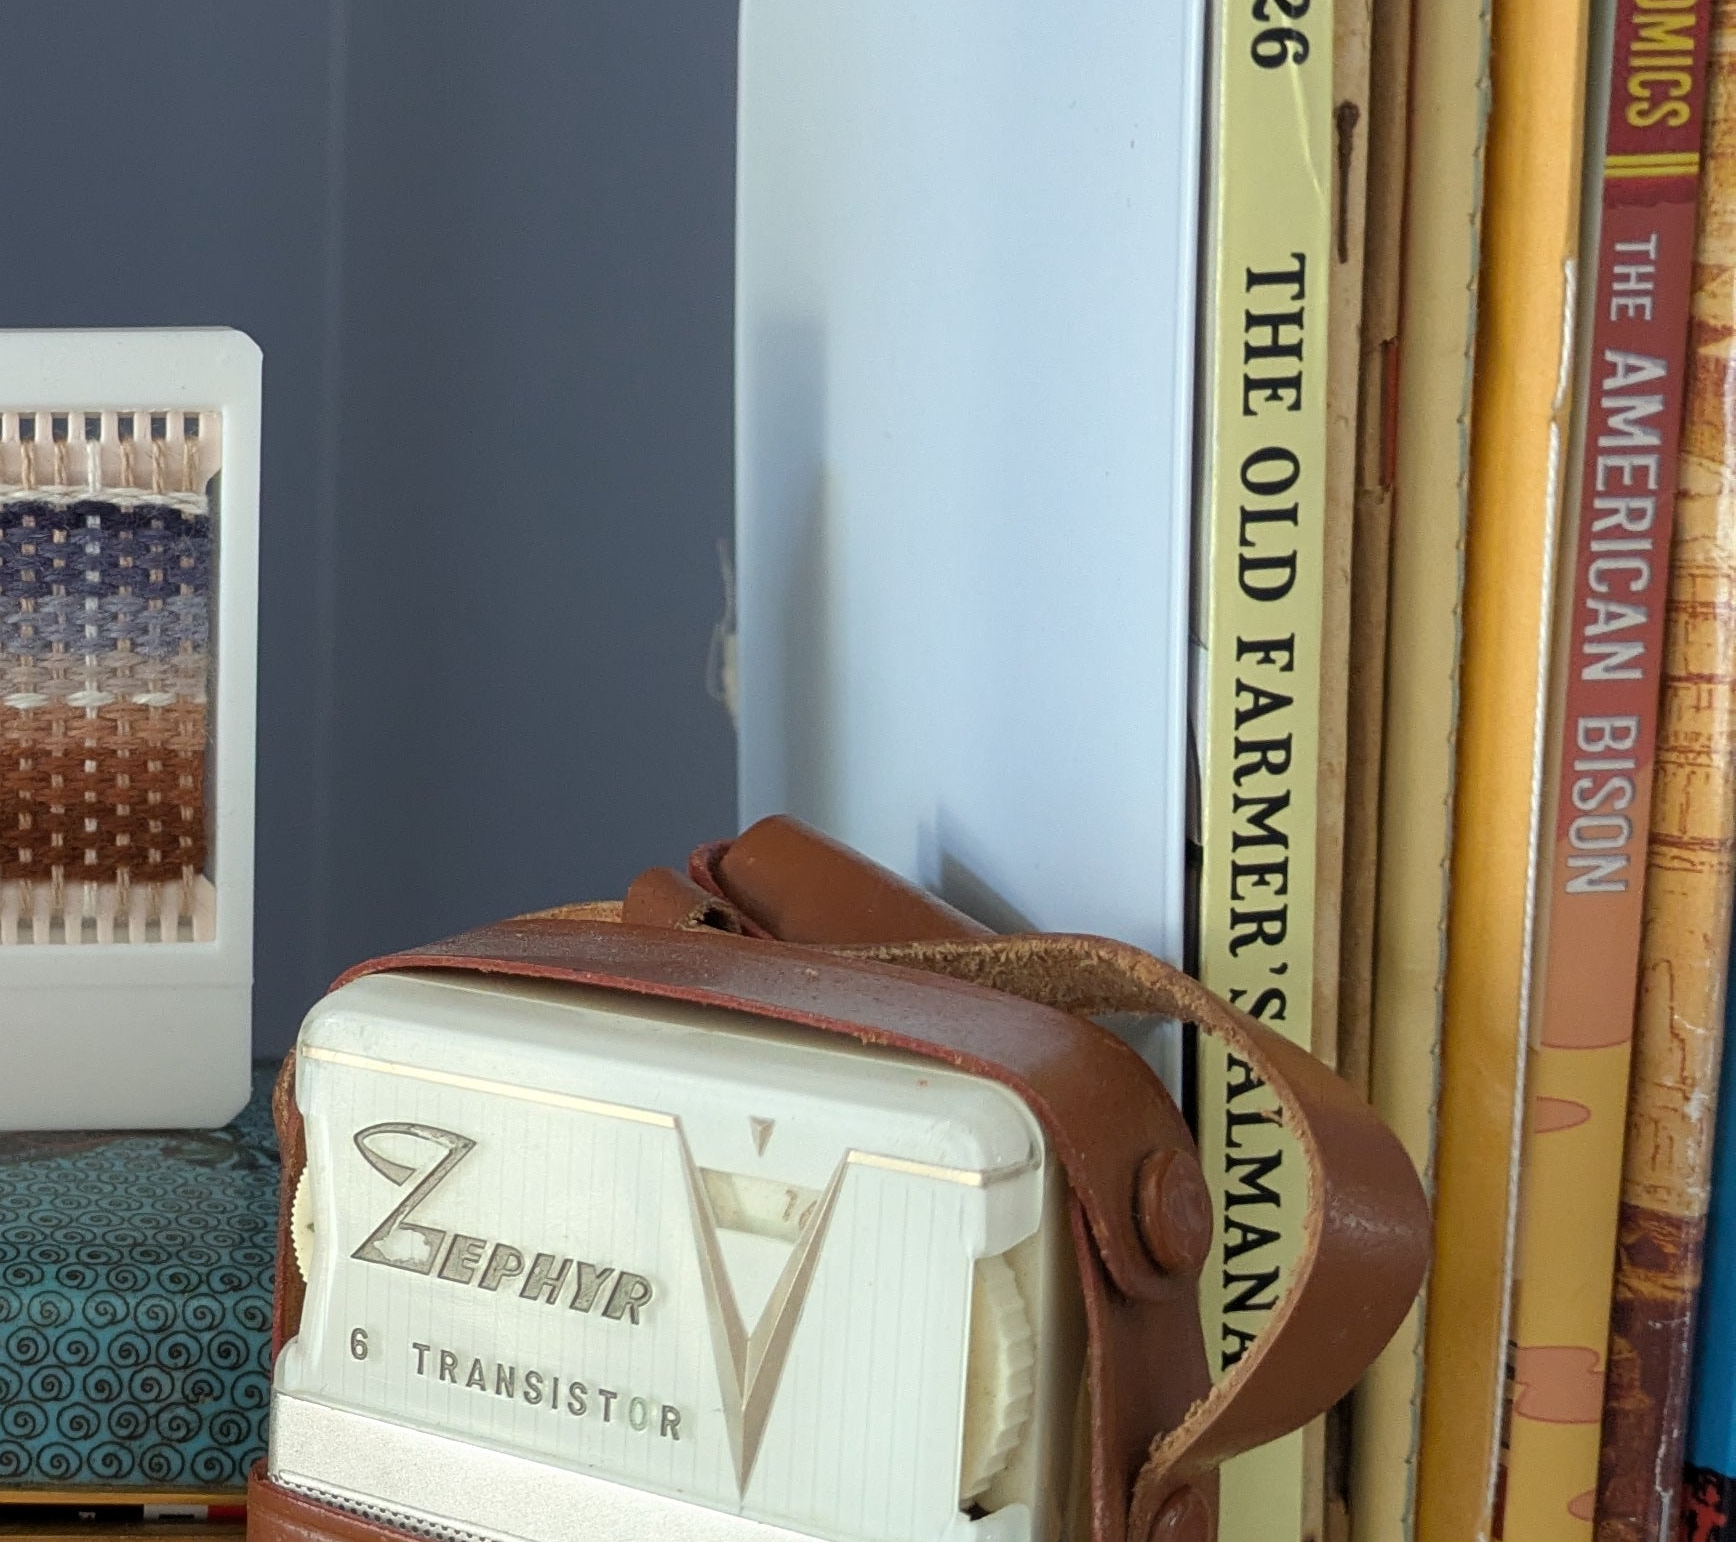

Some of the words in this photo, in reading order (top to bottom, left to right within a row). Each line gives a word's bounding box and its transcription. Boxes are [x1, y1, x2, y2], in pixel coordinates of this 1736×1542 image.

[1241, 253, 1306, 418] THE
[1609, 233, 1657, 322] THE
[1237, 446, 1301, 603] OLD
[1581, 350, 1667, 682] AMERICAN
[1229, 633, 1295, 1025] FARMER'S
[1564, 715, 1640, 895] BISON
[350, 1327, 369, 1361] 6
[413, 1342, 682, 1442] TRANSISTOR
